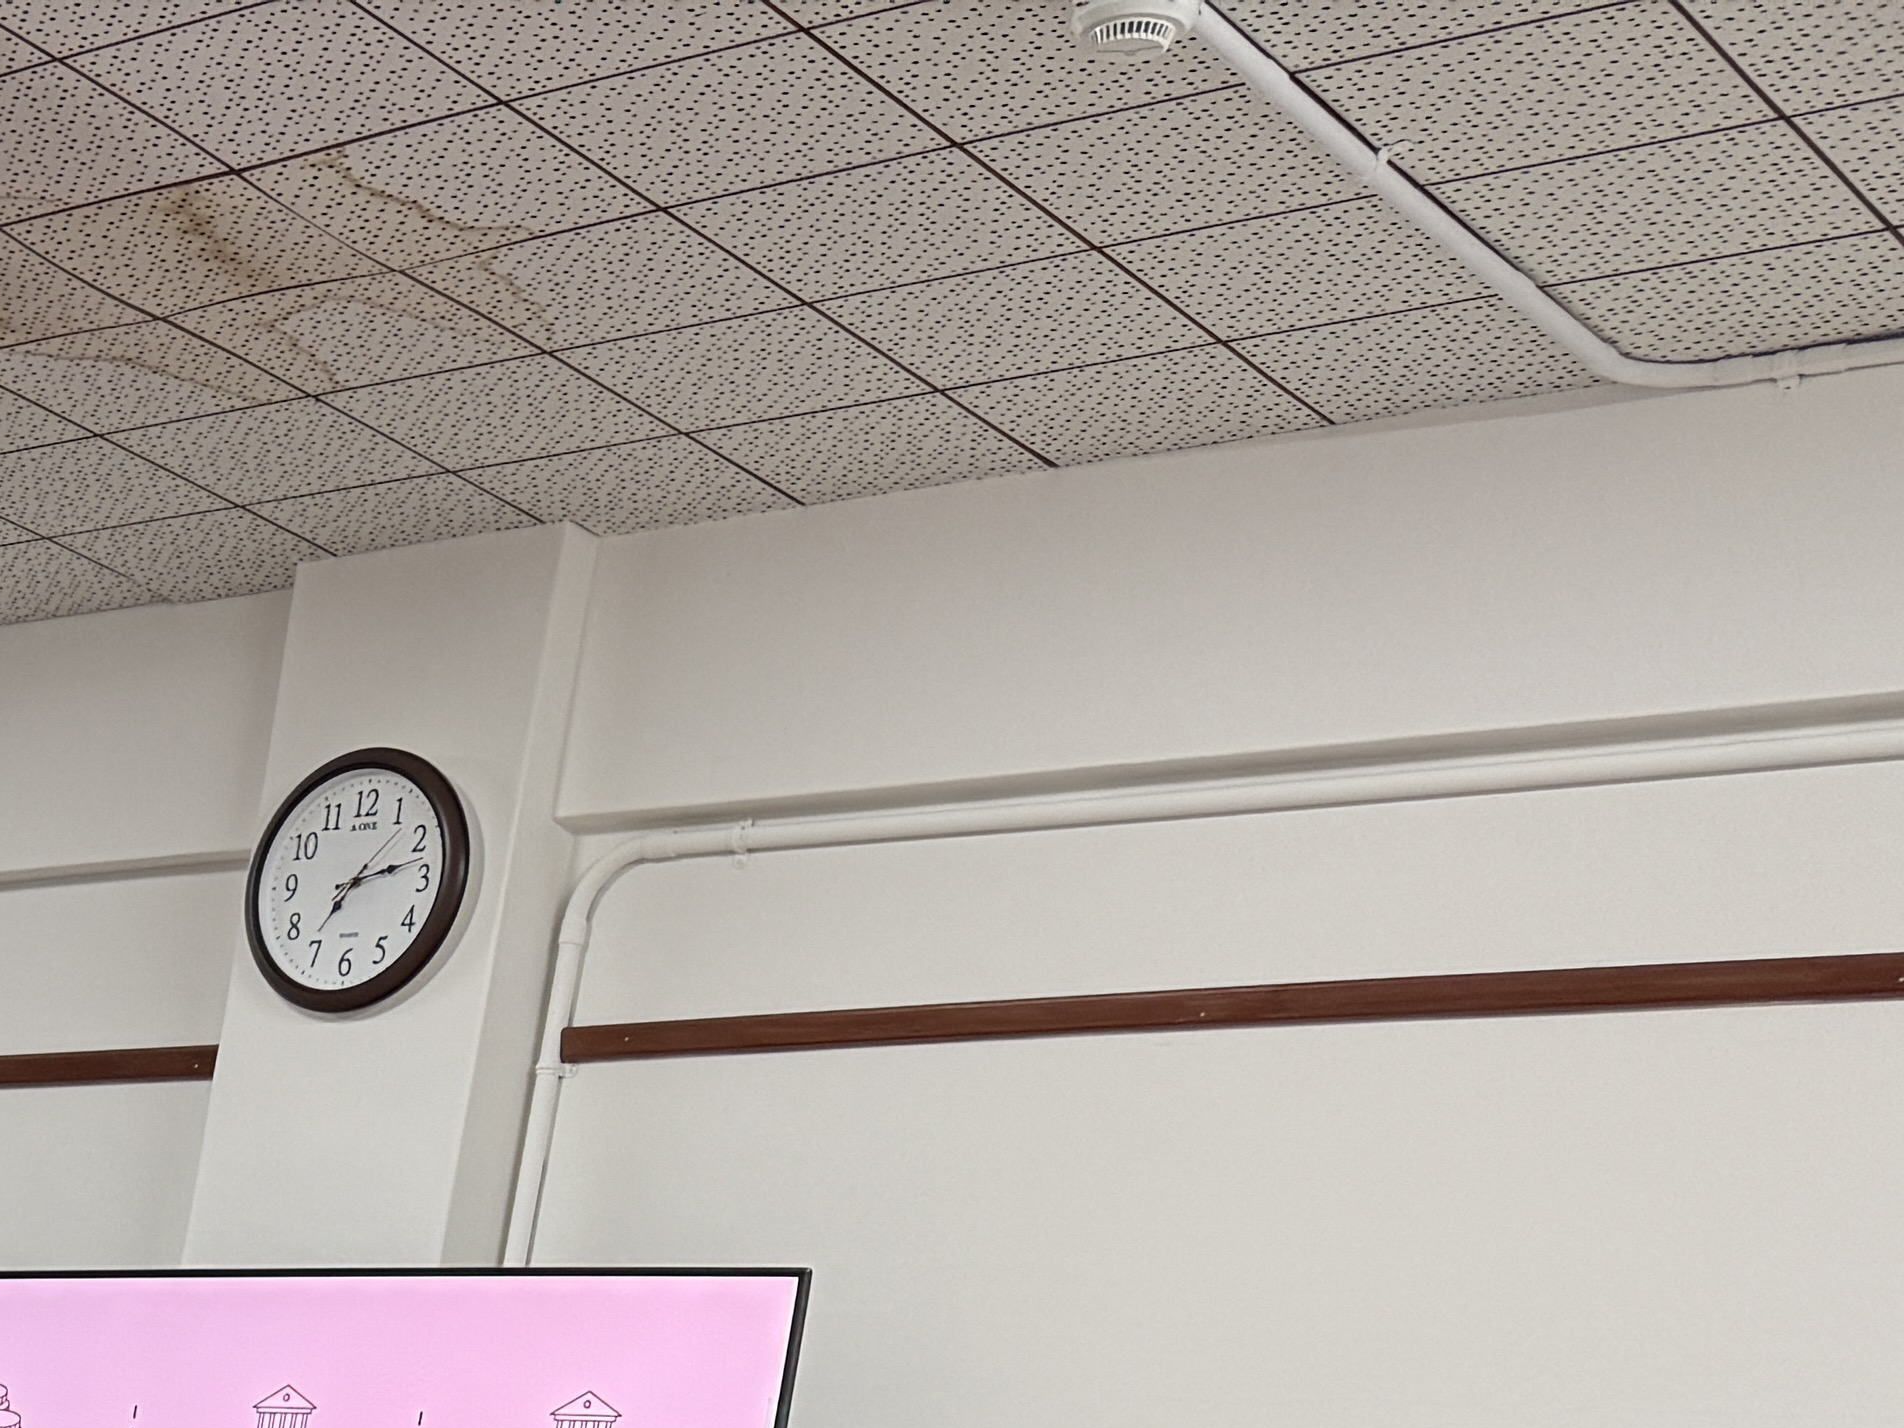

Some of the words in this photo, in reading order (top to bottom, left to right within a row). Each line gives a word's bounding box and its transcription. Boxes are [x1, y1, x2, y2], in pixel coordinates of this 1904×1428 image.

[353, 788, 380, 818] 12
[392, 797, 404, 825] 1
[321, 803, 343, 832] 11
[293, 831, 319, 861] 10
[411, 824, 427, 853] 2
[284, 874, 298, 902] 9
[415, 864, 430, 892] 3
[287, 912, 301, 940] 8
[401, 904, 416, 933] 4
[308, 940, 322, 968] 7
[338, 948, 354, 976] 6
[372, 935, 389, 965] 5
